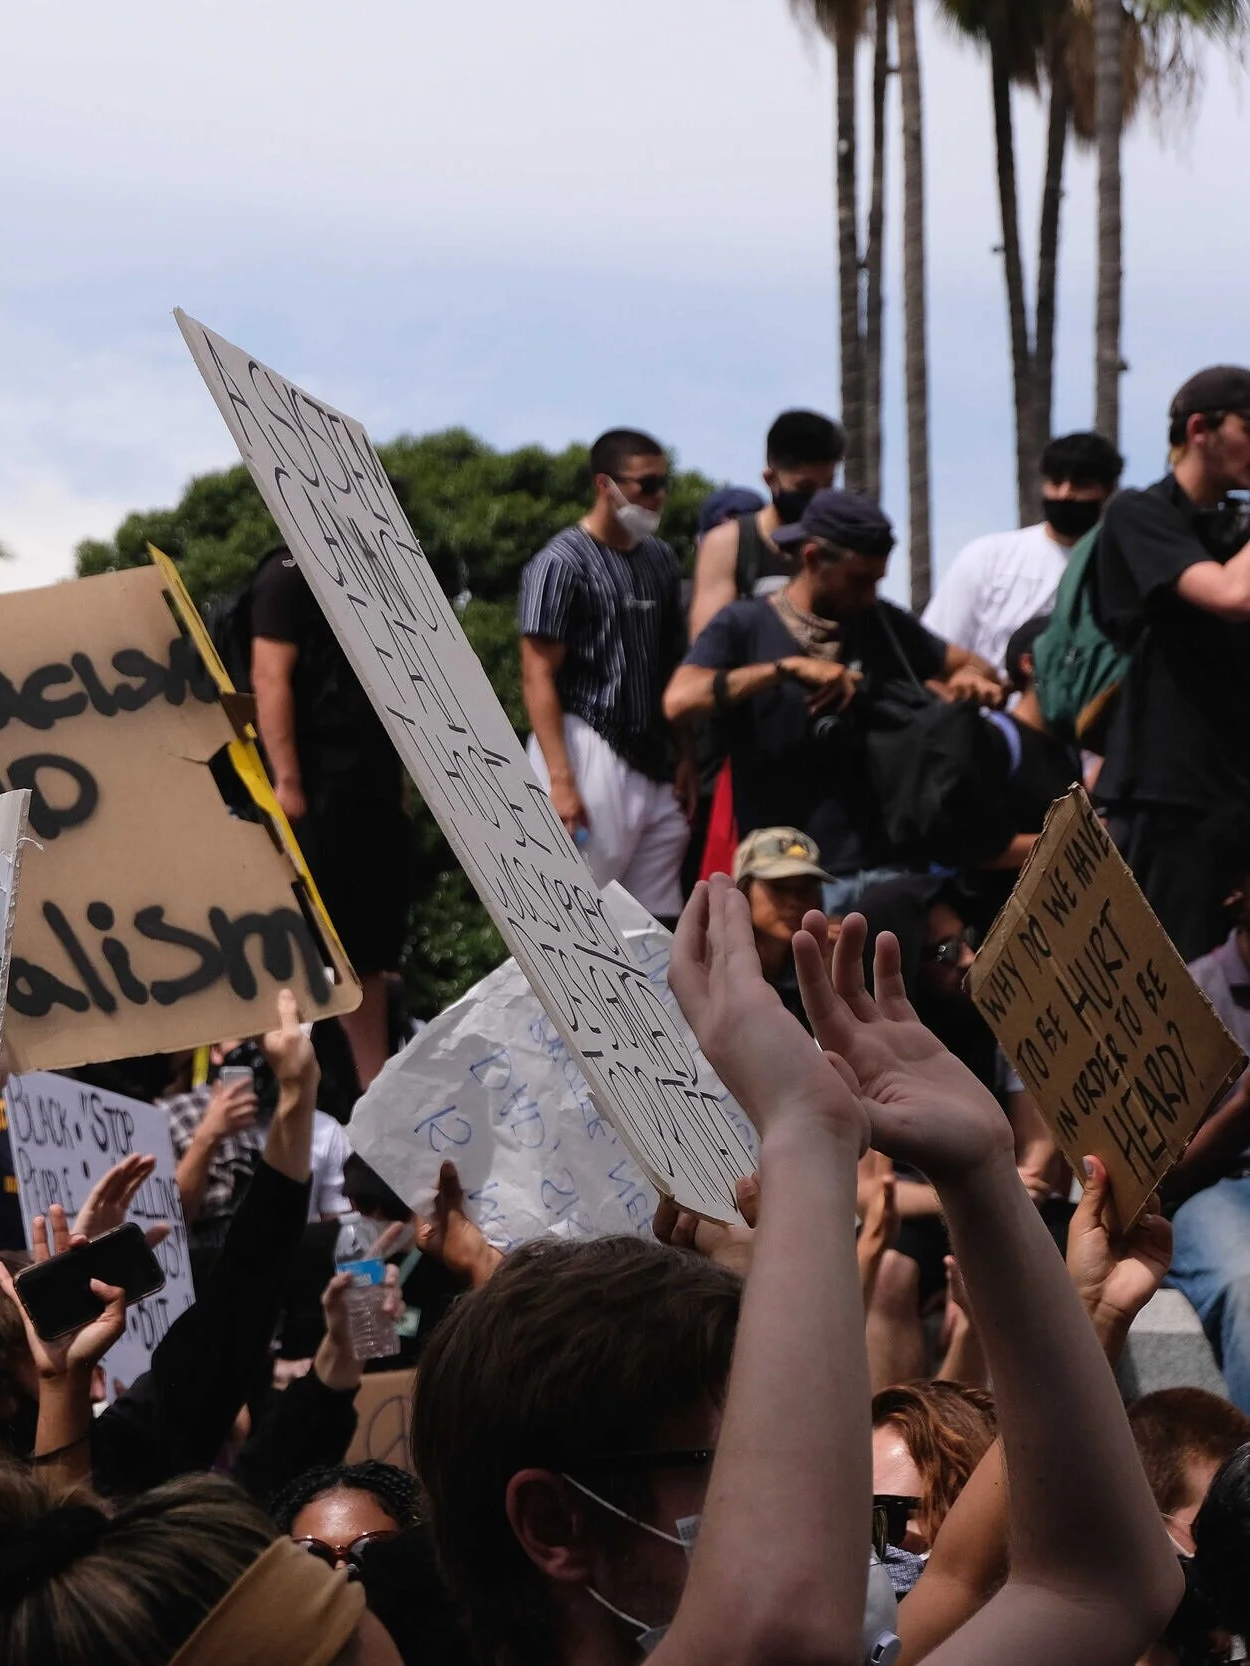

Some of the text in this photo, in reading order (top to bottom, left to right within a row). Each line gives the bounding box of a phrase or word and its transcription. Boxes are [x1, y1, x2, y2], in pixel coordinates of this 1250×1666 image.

[202, 329, 419, 548] A SYSTEM
[275, 467, 456, 641] CANNOT
[347, 593, 511, 764] FAIL
[386, 705, 578, 864] THOSE IT
[980, 809, 1109, 1023] WHY DO WE HAVE
[1017, 897, 1130, 1090] TO BE HURT
[507, 917, 699, 1086] DESIGNED
[1057, 959, 1167, 1143] IN ORDER TO BE
[8, 1074, 74, 1150] BLACK
[581, 1051, 675, 1177] TO
[616, 1061, 757, 1212] PROTECT
[1103, 1020, 1204, 1185] HEARD?
